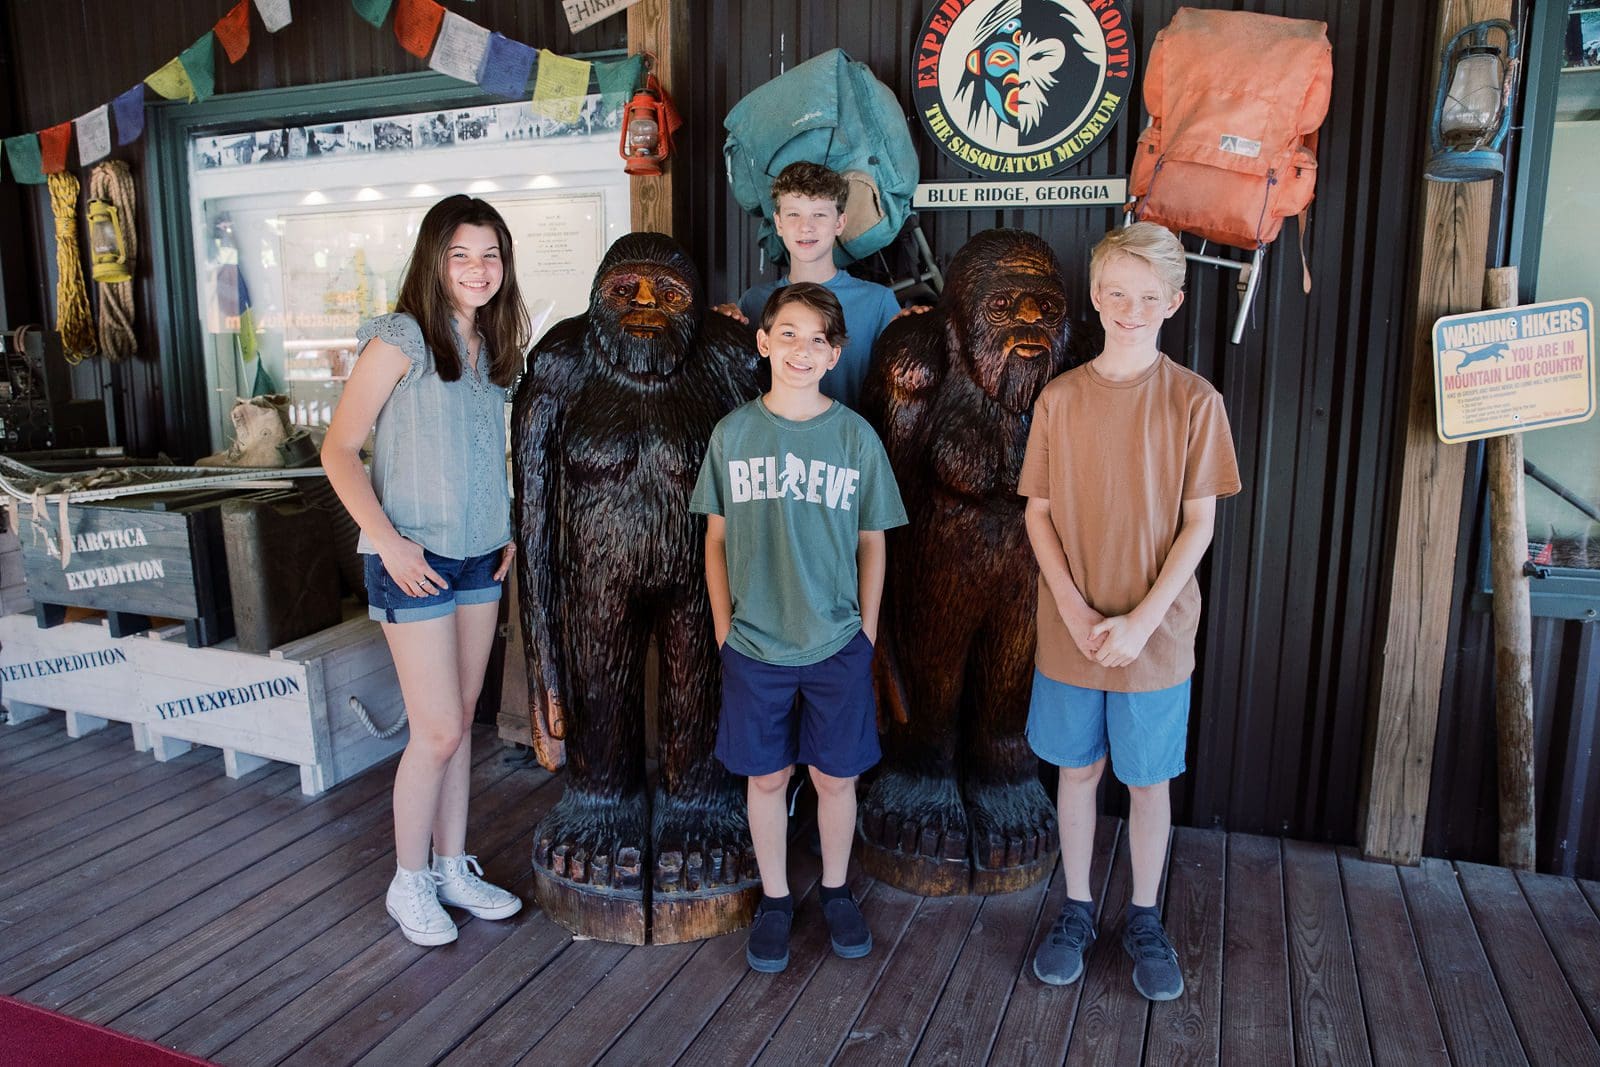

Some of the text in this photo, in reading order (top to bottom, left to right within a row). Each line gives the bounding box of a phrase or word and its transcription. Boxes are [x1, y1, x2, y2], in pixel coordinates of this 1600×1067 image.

[917, 0, 974, 89] EXPED
[924, 91, 1121, 174] THE SASQUATCH MUSEUM
[928, 185, 1110, 204] BLUE RIDGE, GEORGIA
[1442, 308, 1583, 350] WARNING HIKERS
[1511, 340, 1575, 363] YOU ARE IN
[1444, 367, 1502, 391] MOUNTAIN
[1505, 365, 1531, 381] LION
[1534, 355, 1585, 377] COUNTRY
[46, 527, 148, 556] ATARCTICA
[65, 560, 165, 591] EXPEDITION
[0, 648, 127, 682] YETI EXPEDITION
[156, 676, 301, 721] YETI EXPEDITION
